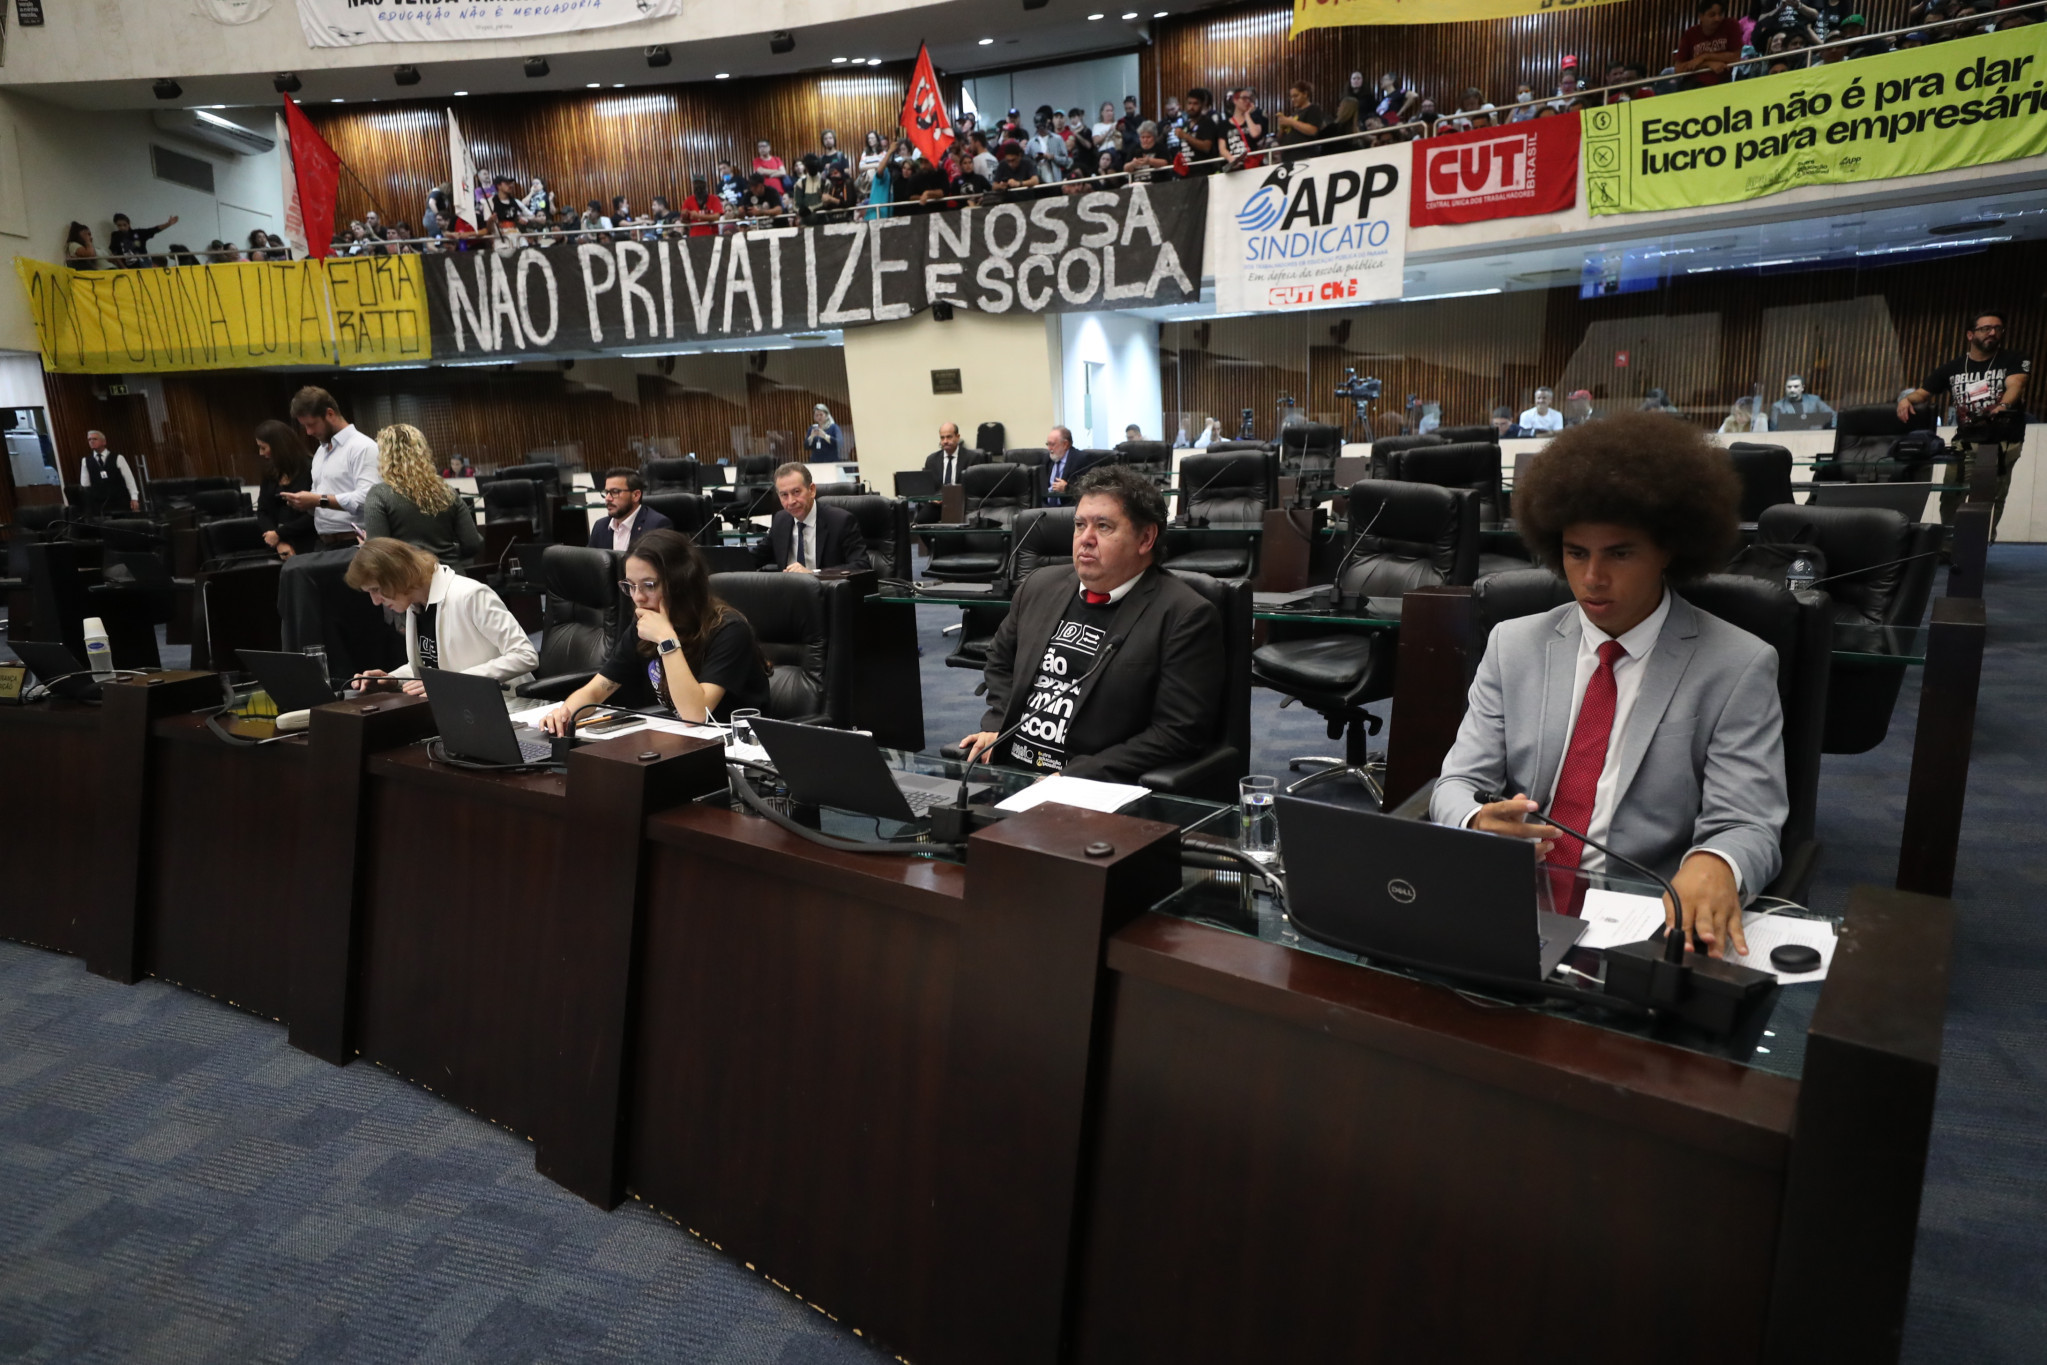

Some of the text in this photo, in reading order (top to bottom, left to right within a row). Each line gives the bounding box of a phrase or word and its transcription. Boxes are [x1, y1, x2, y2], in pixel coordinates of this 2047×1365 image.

[378, 0, 602, 26] EDUCAÇÃO NÃO É MERCADORIA
[1642, 54, 2034, 145] Escola não é pra dar
[1428, 138, 1525, 196] CUT
[1526, 132, 1537, 190] BRASIL
[1641, 145, 1727, 175] lucro
[1735, 125, 1817, 169] para
[928, 181, 1163, 259] NOSSA
[1280, 163, 1399, 231] APP
[1246, 219, 1390, 261] SINDICATO
[326, 253, 418, 307] FORA
[578, 214, 912, 343] PRIVATIZE
[924, 241, 1195, 313] ESCOLA
[1248, 272, 1264, 281] Em
[1299, 267, 1312, 279] da
[1315, 263, 1343, 277] escola
[1344, 258, 1386, 277] pública
[238, 262, 327, 357] LUTA
[1269, 285, 1314, 305] CUT
[336, 309, 420, 354] RATO
[1955, 371, 1981, 385] BELLA
[1042, 647, 1068, 676] ão
[1029, 690, 1074, 720] min
[1020, 713, 1068, 745] scol
[1391, 885, 1413, 897] DELL
